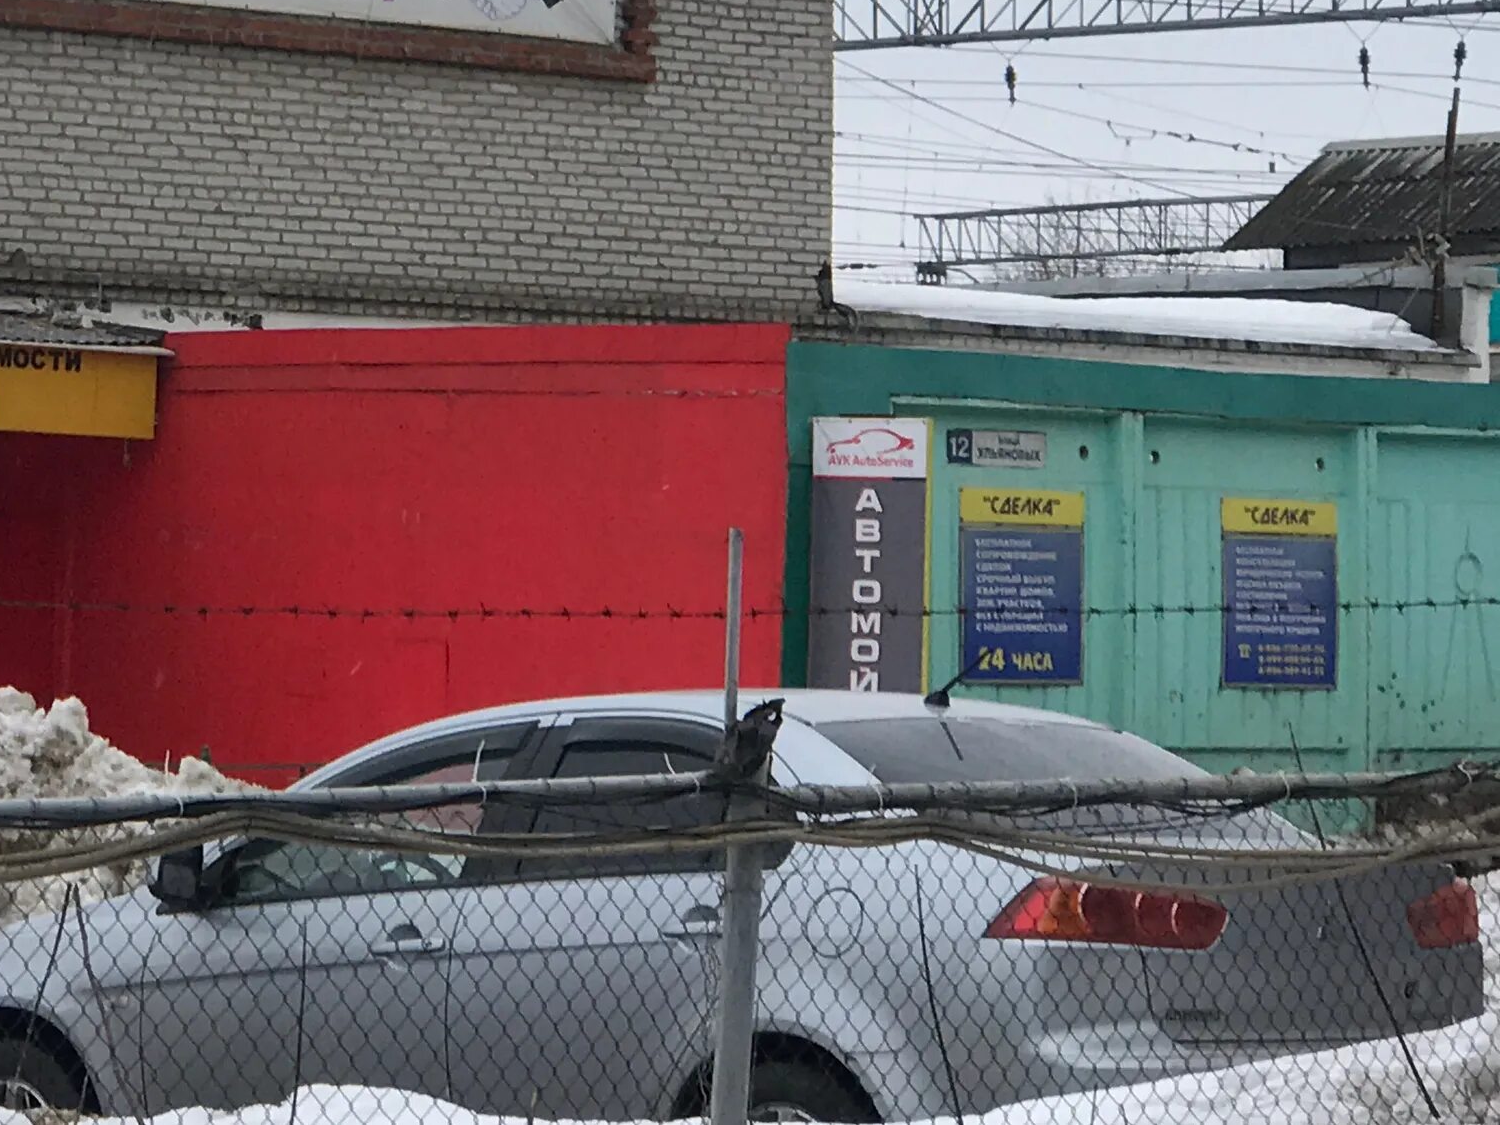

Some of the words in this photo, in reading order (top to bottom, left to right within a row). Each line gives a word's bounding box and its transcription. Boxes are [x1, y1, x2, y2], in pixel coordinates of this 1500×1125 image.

[949, 436, 970, 458] 12
[828, 455, 851, 466] AVK
[853, 455, 914, 468] AutoService
[1011, 652, 1054, 672] ЧАСА
